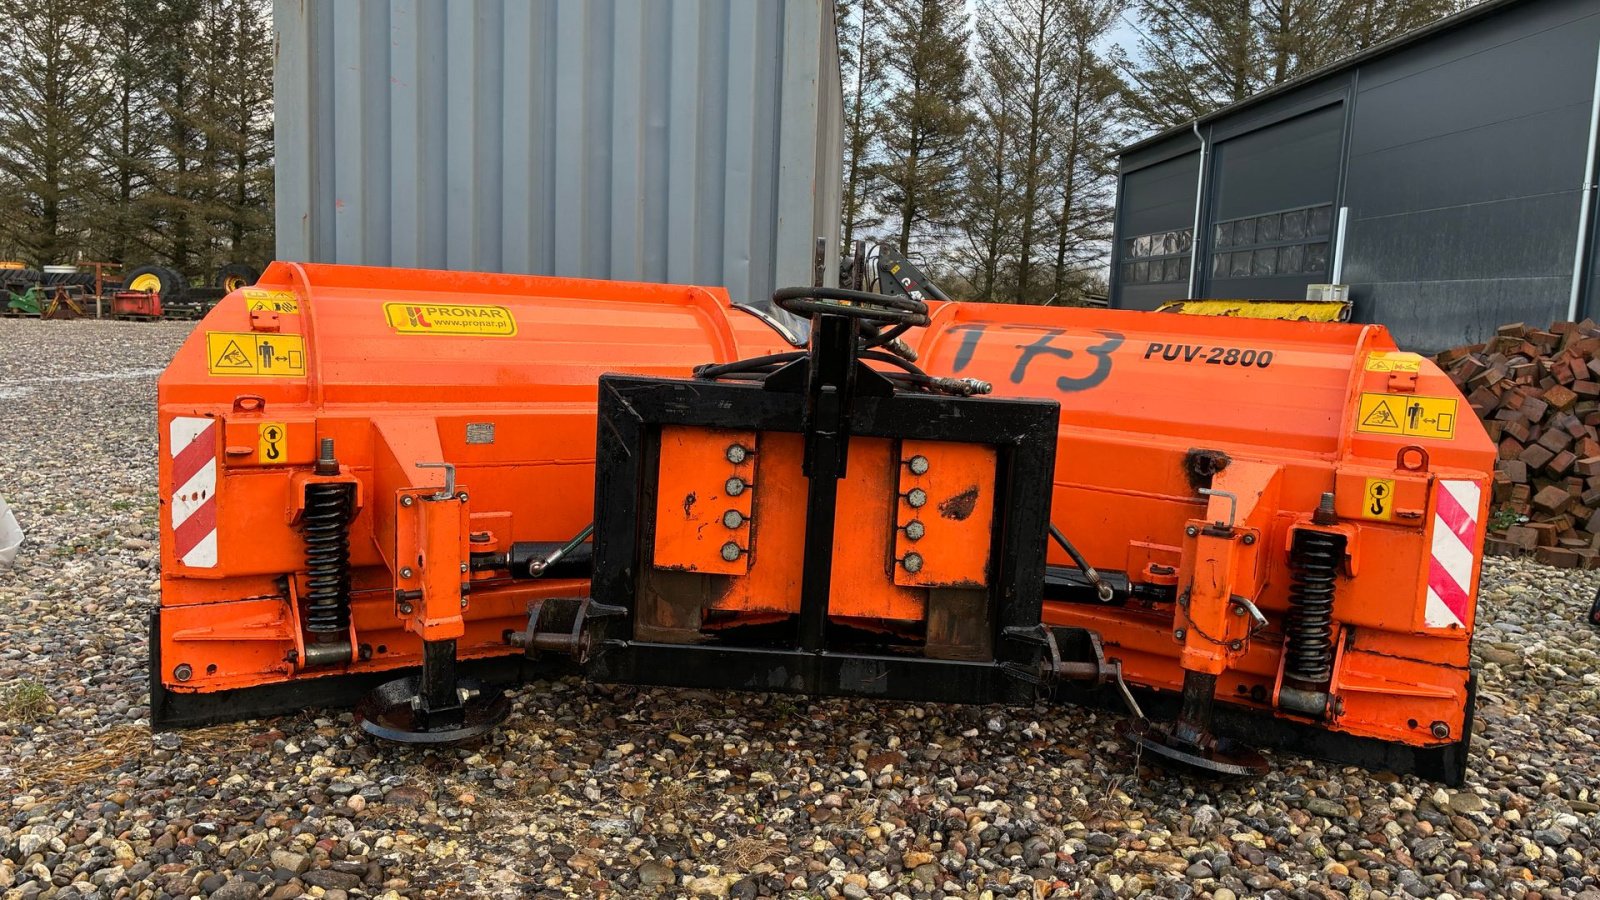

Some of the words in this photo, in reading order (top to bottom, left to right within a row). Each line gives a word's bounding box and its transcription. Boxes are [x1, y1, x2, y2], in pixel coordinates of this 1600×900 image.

[426, 307, 503, 318] PRONAR
[434, 319, 507, 328] www.pronar.pl
[945, 320, 1126, 393] 173
[1143, 342, 1273, 369] PUV-2800
